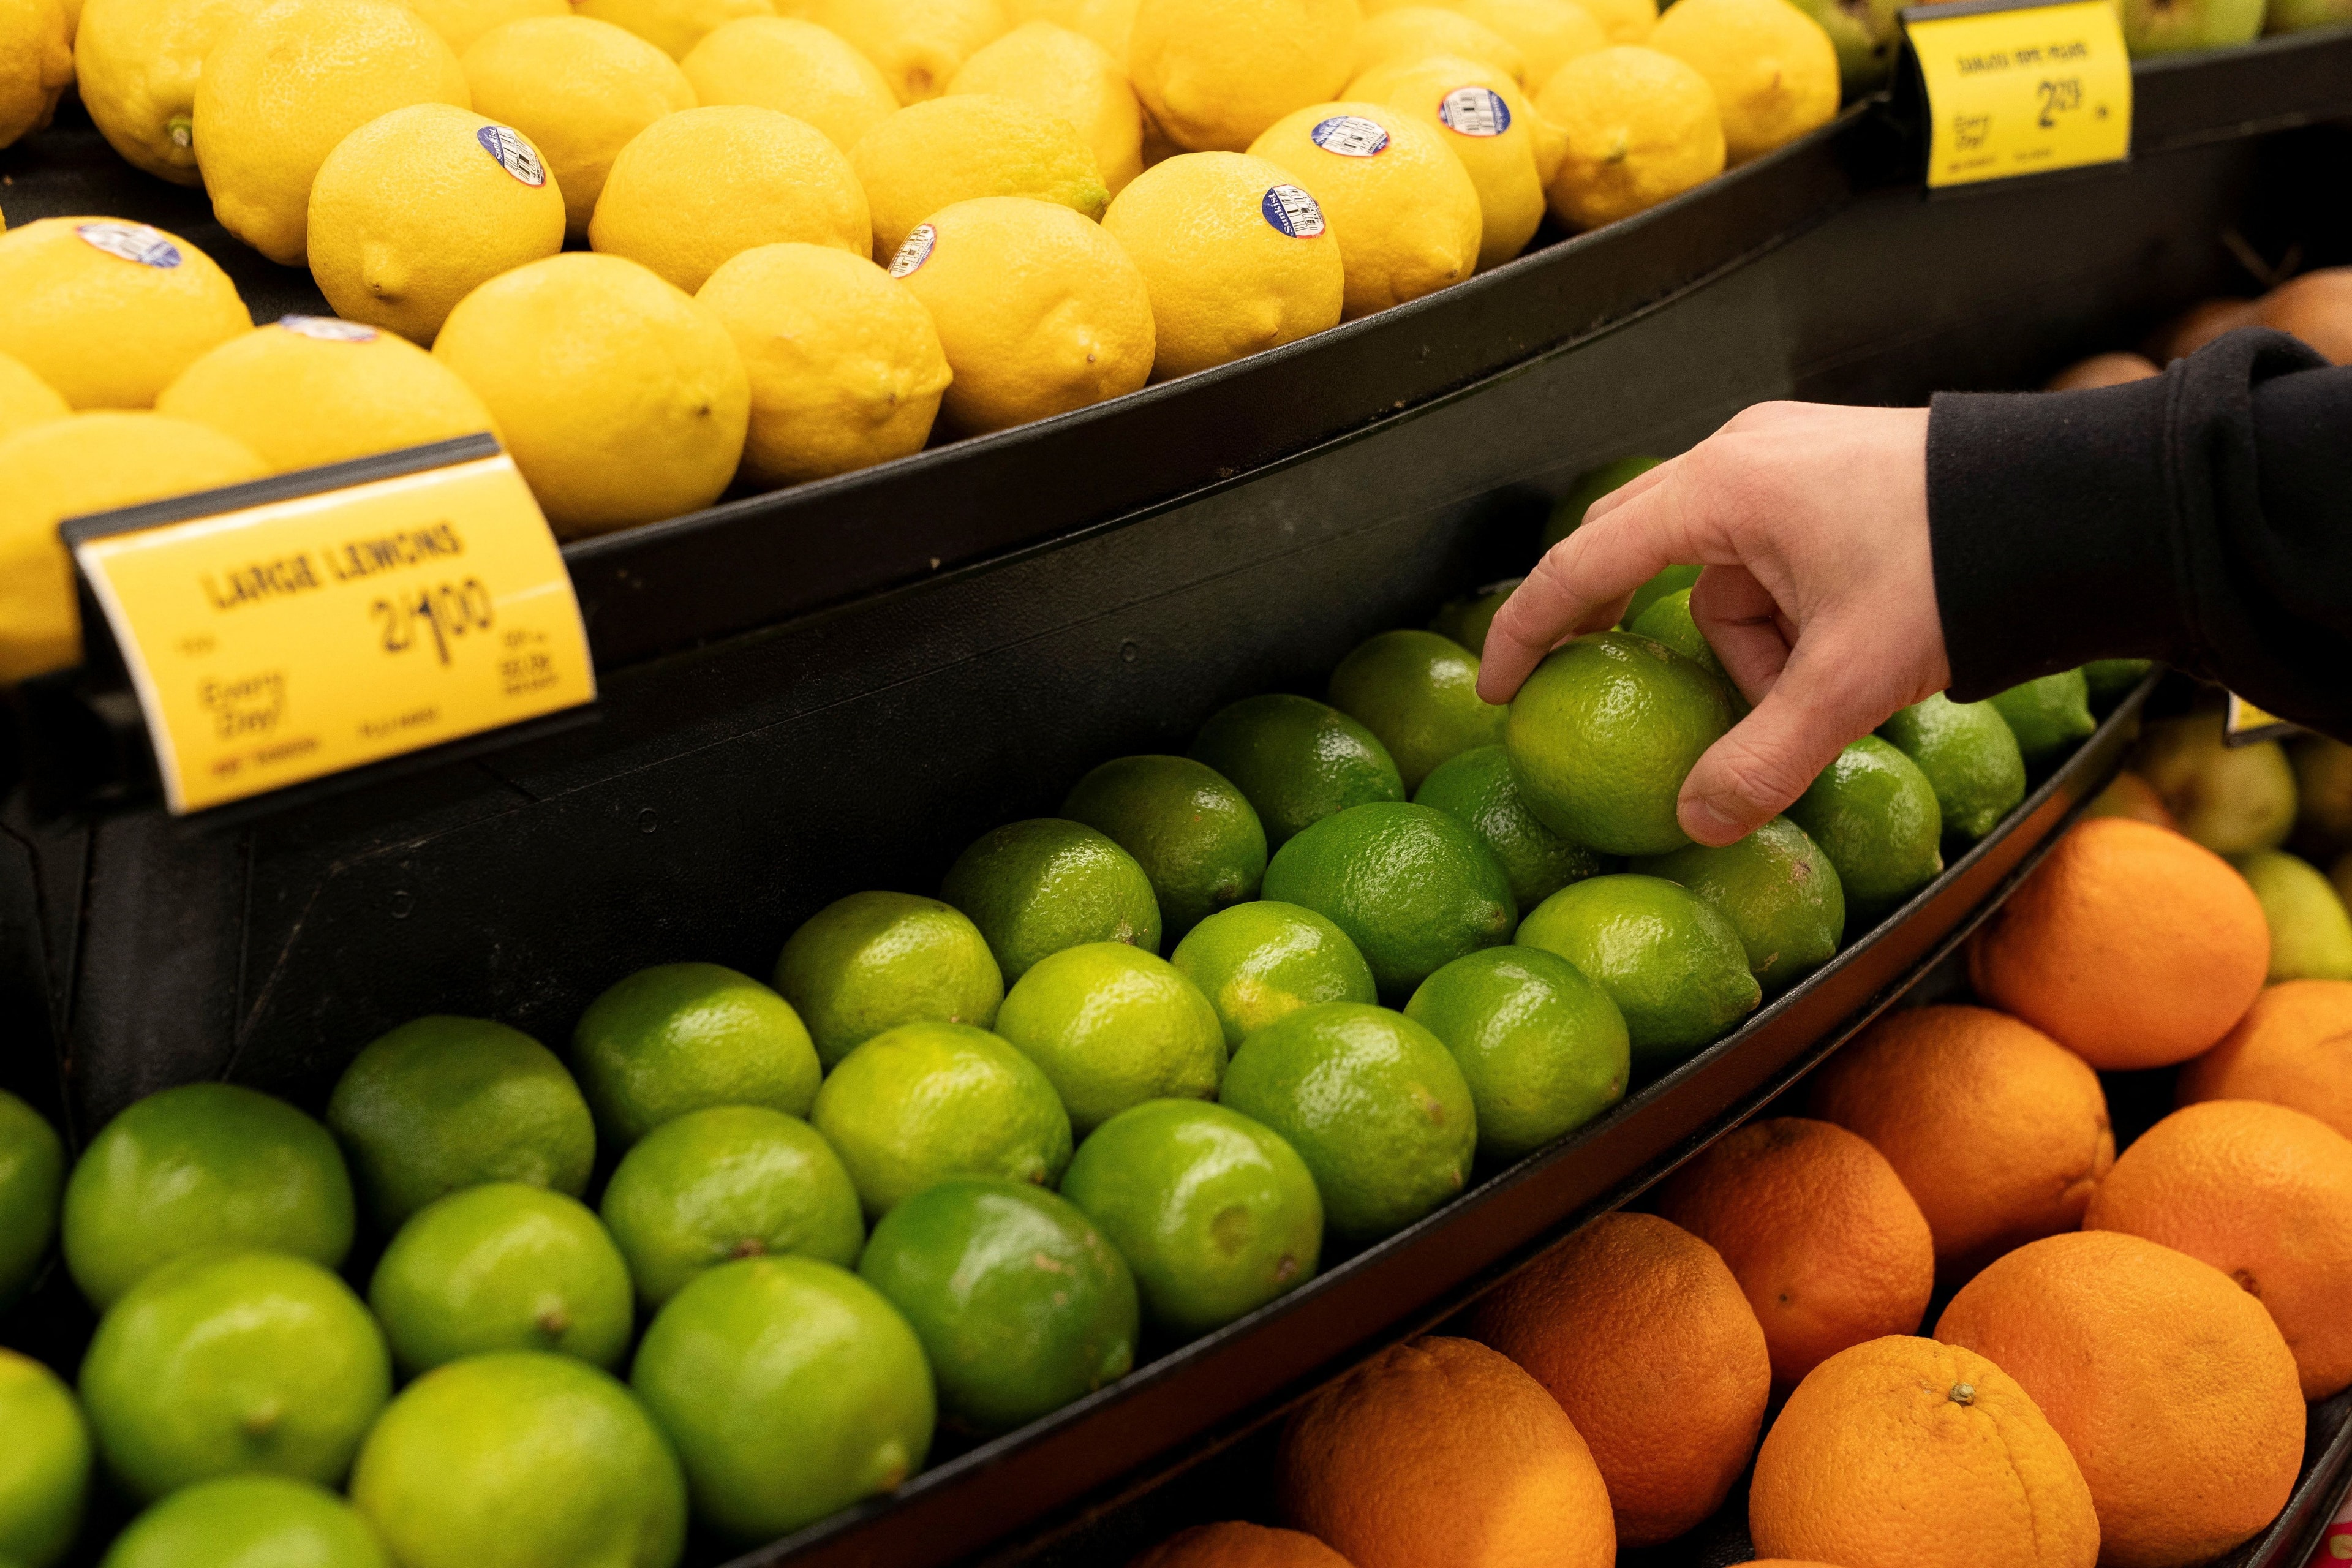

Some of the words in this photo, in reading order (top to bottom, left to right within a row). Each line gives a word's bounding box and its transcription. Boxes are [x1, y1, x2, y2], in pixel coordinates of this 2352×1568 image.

[489, 128, 503, 161] Sunkist
[1268, 192, 1292, 233] Sunkist
[201, 555, 322, 610] LARGE
[323, 522, 463, 582] LEMONS
